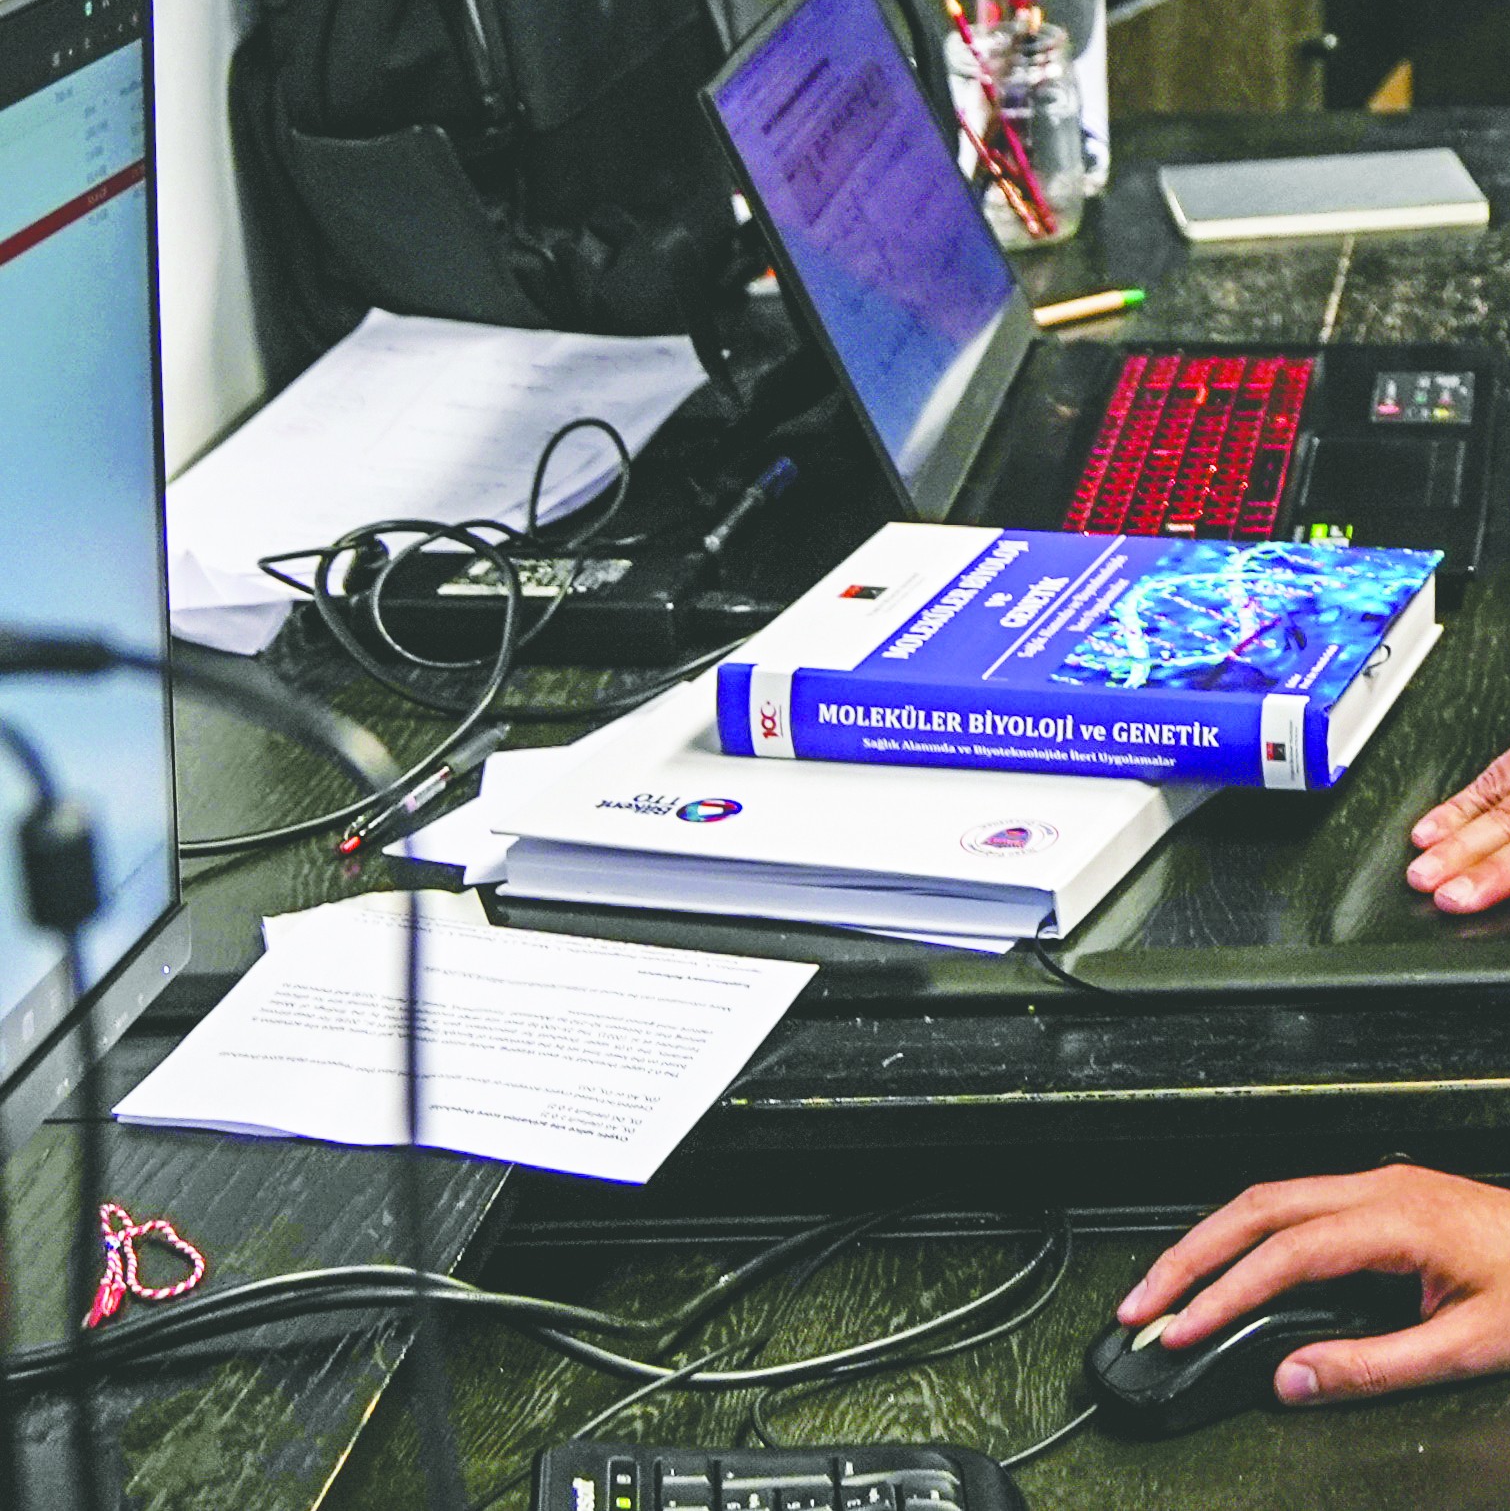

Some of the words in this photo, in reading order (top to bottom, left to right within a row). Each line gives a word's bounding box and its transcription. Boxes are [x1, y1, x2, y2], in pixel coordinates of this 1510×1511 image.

[984, 592, 1014, 608] ve
[999, 575, 1071, 628] GENETİK
[817, 702, 962, 734] MOLEKÜLER
[968, 709, 1074, 743] BİYOLOJİ
[1079, 724, 1107, 742] ve
[1112, 721, 1220, 748] GENETİK
[862, 737, 901, 752] Sağlık
[957, 744, 973, 755] ve
